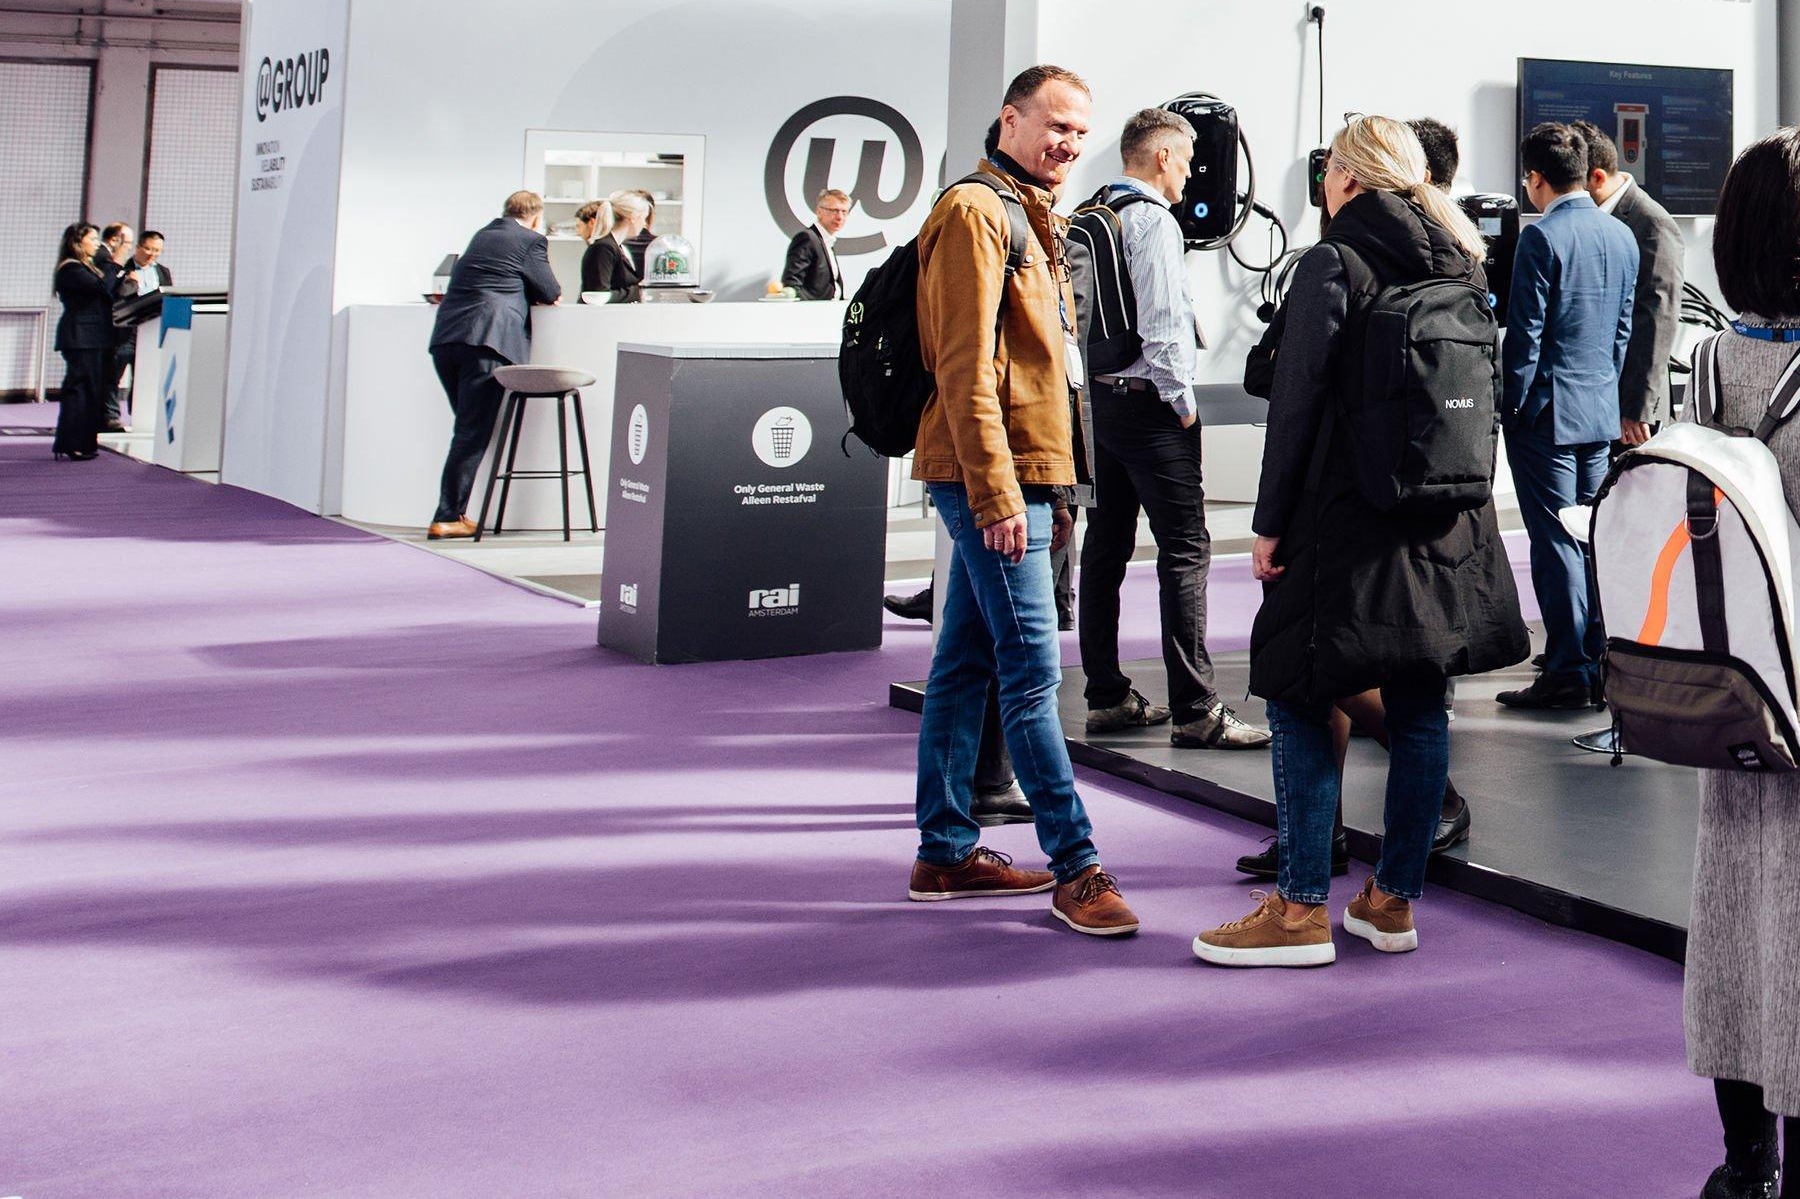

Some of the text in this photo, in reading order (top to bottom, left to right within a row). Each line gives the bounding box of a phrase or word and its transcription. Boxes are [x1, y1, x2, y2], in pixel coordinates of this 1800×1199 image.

[1609, 69, 1653, 82] Key Features
[1445, 398, 1474, 409] NOVUS
[733, 482, 825, 496] Only General Waste
[741, 493, 817, 506] Alleen Restafval
[619, 583, 638, 607] rai
[748, 583, 800, 609] rai
[748, 608, 799, 618] AMSTERDAM
